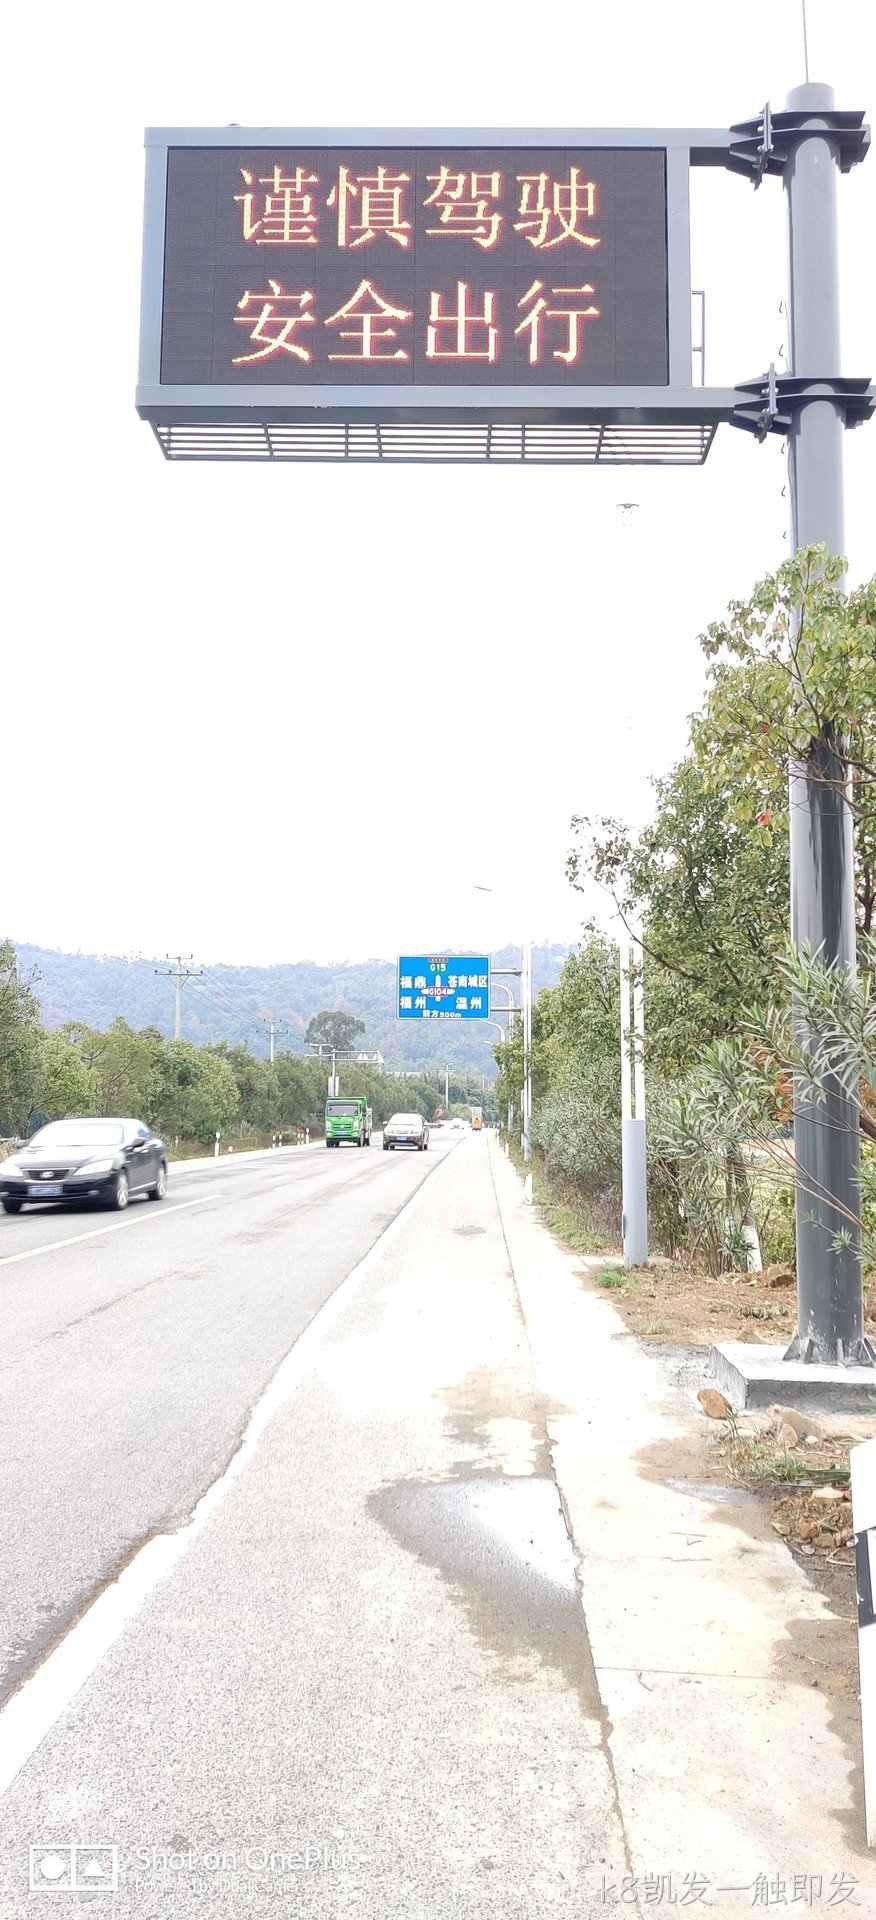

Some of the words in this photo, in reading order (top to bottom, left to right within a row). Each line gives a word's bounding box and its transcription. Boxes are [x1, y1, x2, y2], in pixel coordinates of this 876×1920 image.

[233, 165, 600, 248] 谨慎驾驶
[232, 279, 600, 364] 安全出行
[429, 963, 447, 972] G15
[447, 975, 488, 988] 苍南城区
[428, 988, 448, 996] G104
[400, 996, 427, 1010] 福州
[455, 997, 482, 1010] 温州
